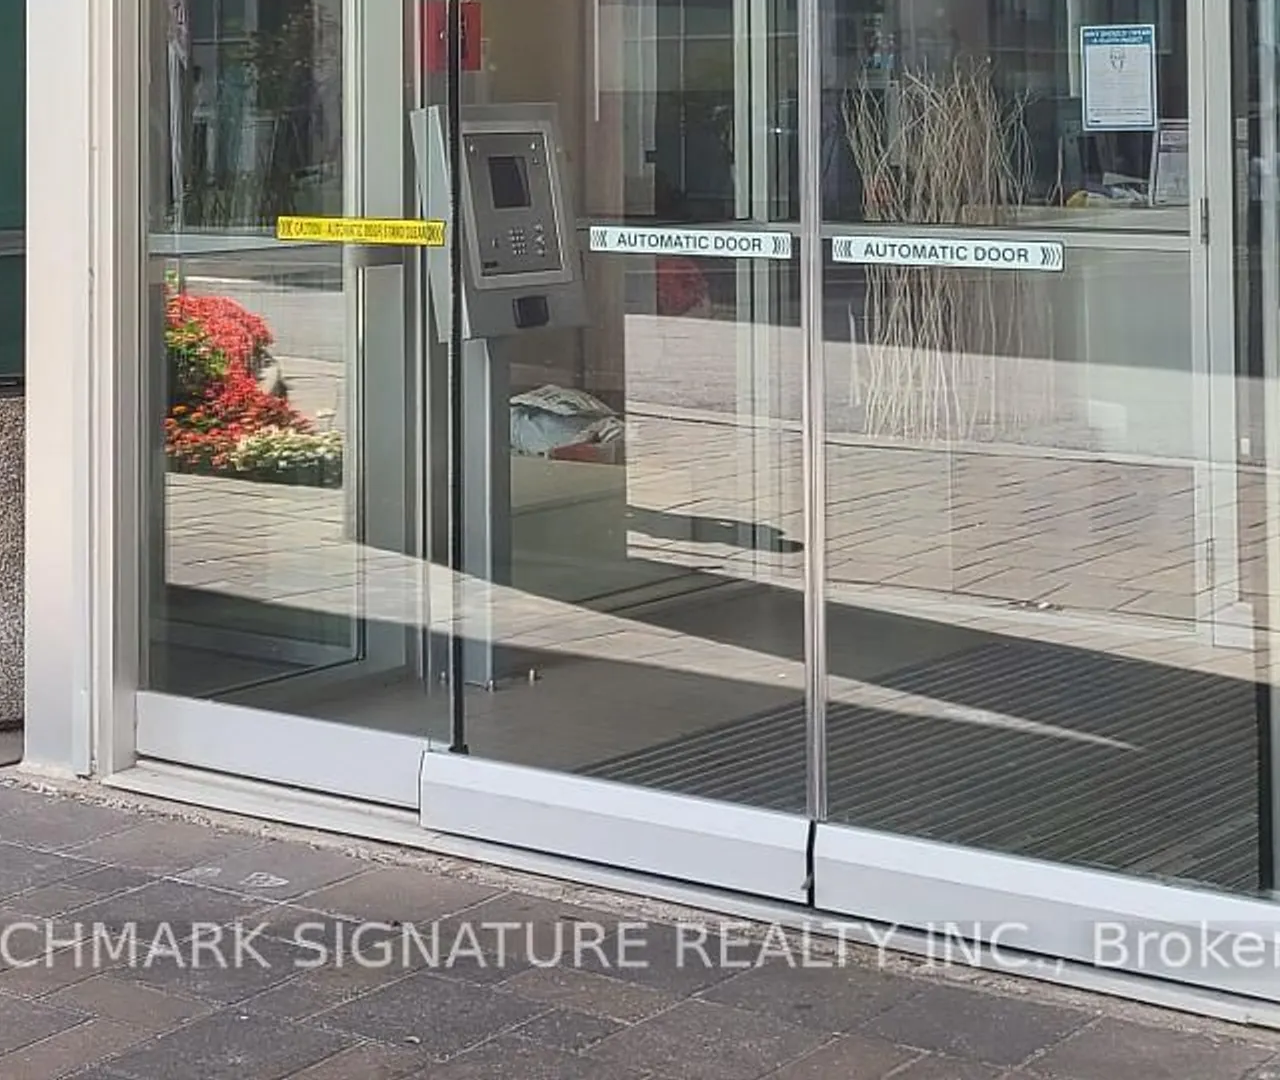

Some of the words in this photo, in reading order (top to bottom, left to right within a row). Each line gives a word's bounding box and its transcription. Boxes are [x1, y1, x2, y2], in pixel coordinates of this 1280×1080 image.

[617, 233, 709, 250] AUTOMATIC
[714, 237, 763, 252] DOOR
[864, 243, 968, 261] AUTOMATIC
[974, 247, 1029, 263] DOOR
